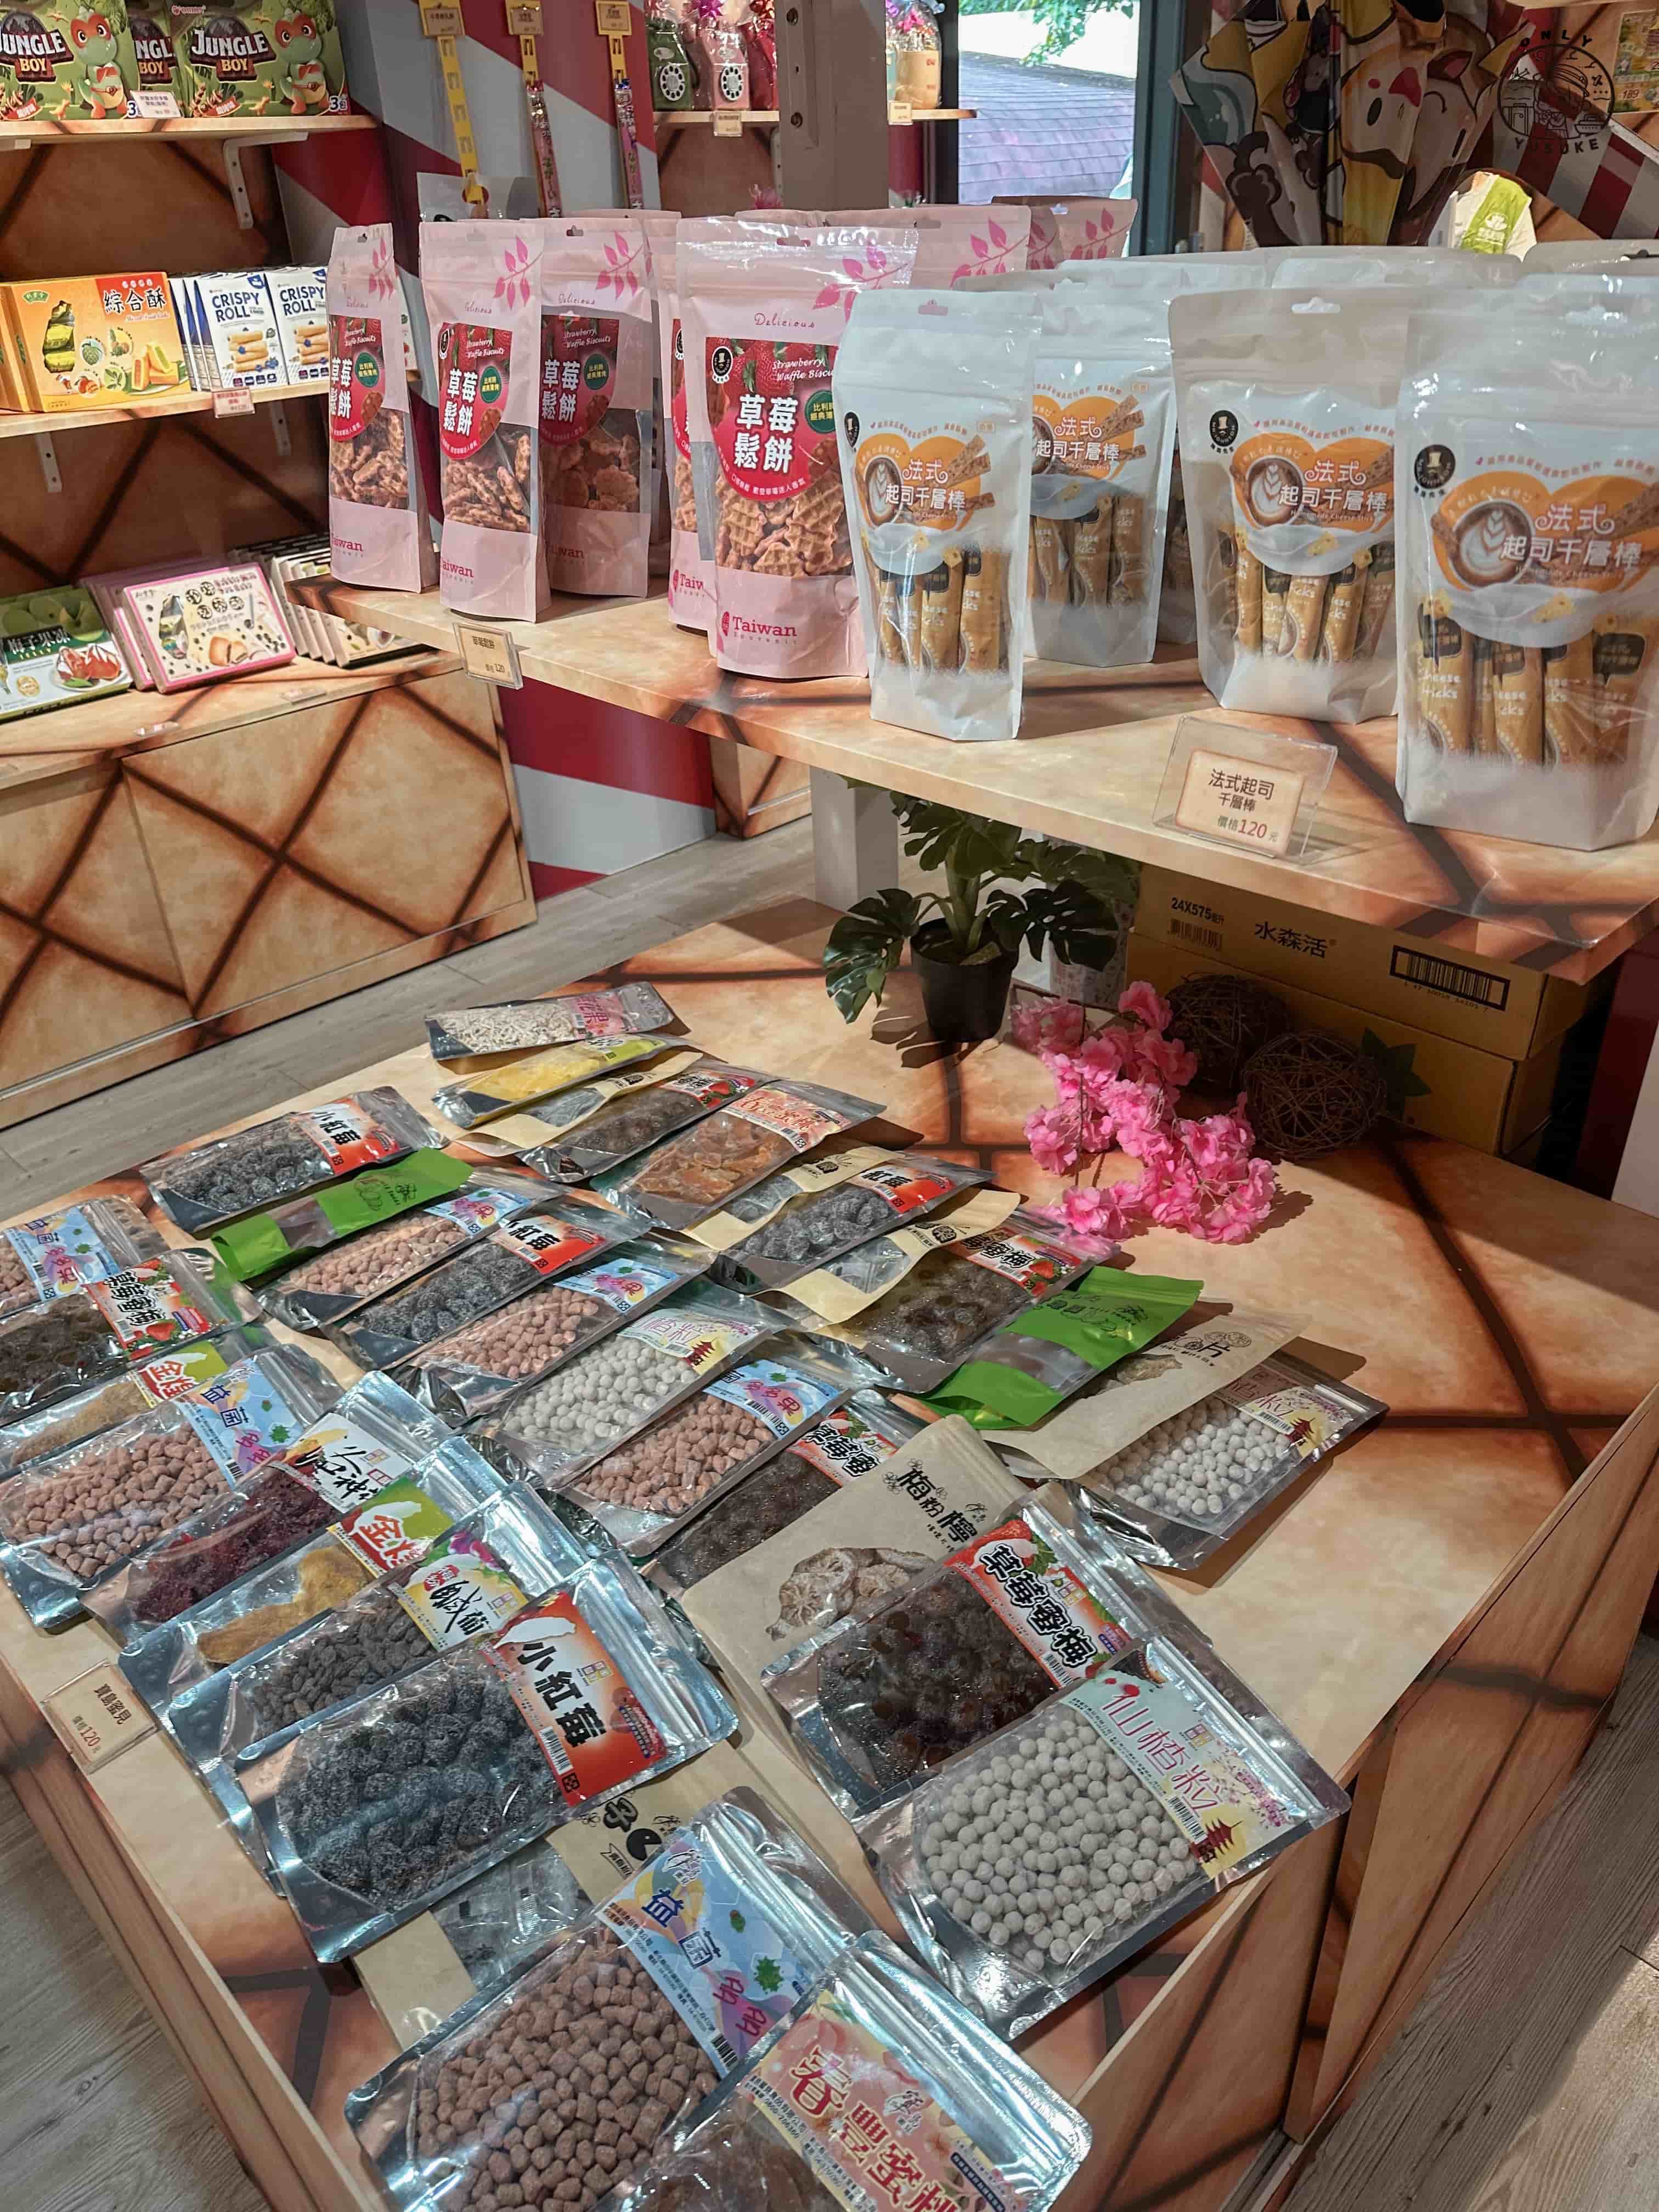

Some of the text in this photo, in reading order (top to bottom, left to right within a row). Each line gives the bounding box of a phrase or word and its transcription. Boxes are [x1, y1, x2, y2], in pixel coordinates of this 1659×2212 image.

[0, 30, 65, 55] UNGLE
[191, 27, 268, 57] JUNGLE
[1520, 30, 1593, 47] ONLY
[19, 58, 47, 72] BOY
[222, 58, 248, 72] BOY
[1623, 89, 1640, 100] 189
[104, 287, 166, 314] 綜合酥
[212, 291, 259, 309] CRISPY
[279, 285, 324, 303] CRISPY
[215, 305, 250, 323] ROLL
[283, 299, 316, 317] ROLL
[754, 312, 815, 329] Delicious
[563, 328, 597, 340] Strawberry
[566, 334, 612, 348] Waffle Biscuits
[543, 358, 580, 391] 草莓
[772, 357, 827, 371] Strawberry
[776, 370, 808, 382] Waffle
[447, 368, 478, 404] 草莓
[443, 400, 472, 433] 鬆餅
[542, 391, 576, 423] 鬆餅
[736, 393, 799, 434] 草莓
[1053, 416, 1102, 438] 法式
[733, 433, 793, 474] 鬆餅
[1036, 439, 1120, 462] 起司千層棒
[902, 458, 949, 484] 法式
[1303, 459, 1367, 486] 法式
[885, 483, 966, 512] 起司千層棒
[1277, 484, 1388, 513] 起司千層棒
[1535, 503, 1616, 535] 法式
[1499, 534, 1643, 569] 起司千層棒
[443, 560, 474, 579] aiwan
[732, 616, 797, 637] Taiwan
[1208, 768, 1275, 800] 法式起司
[1218, 792, 1257, 812] 千層棒
[1255, 921, 1329, 959] 水森活
[311, 1111, 362, 1146] 小紅莓
[103, 1269, 167, 1327] 草莓蜜梅
[897, 1468, 978, 1543] 梅粉檸
[979, 1542, 1097, 1668] 草莓蜜梅
[516, 1641, 607, 1748] 小紅莓
[1102, 1694, 1222, 1812] 仙楂粒
[641, 1888, 768, 2038] 益菌多多
[791, 2046, 960, 2212] 春豐蜜桃
